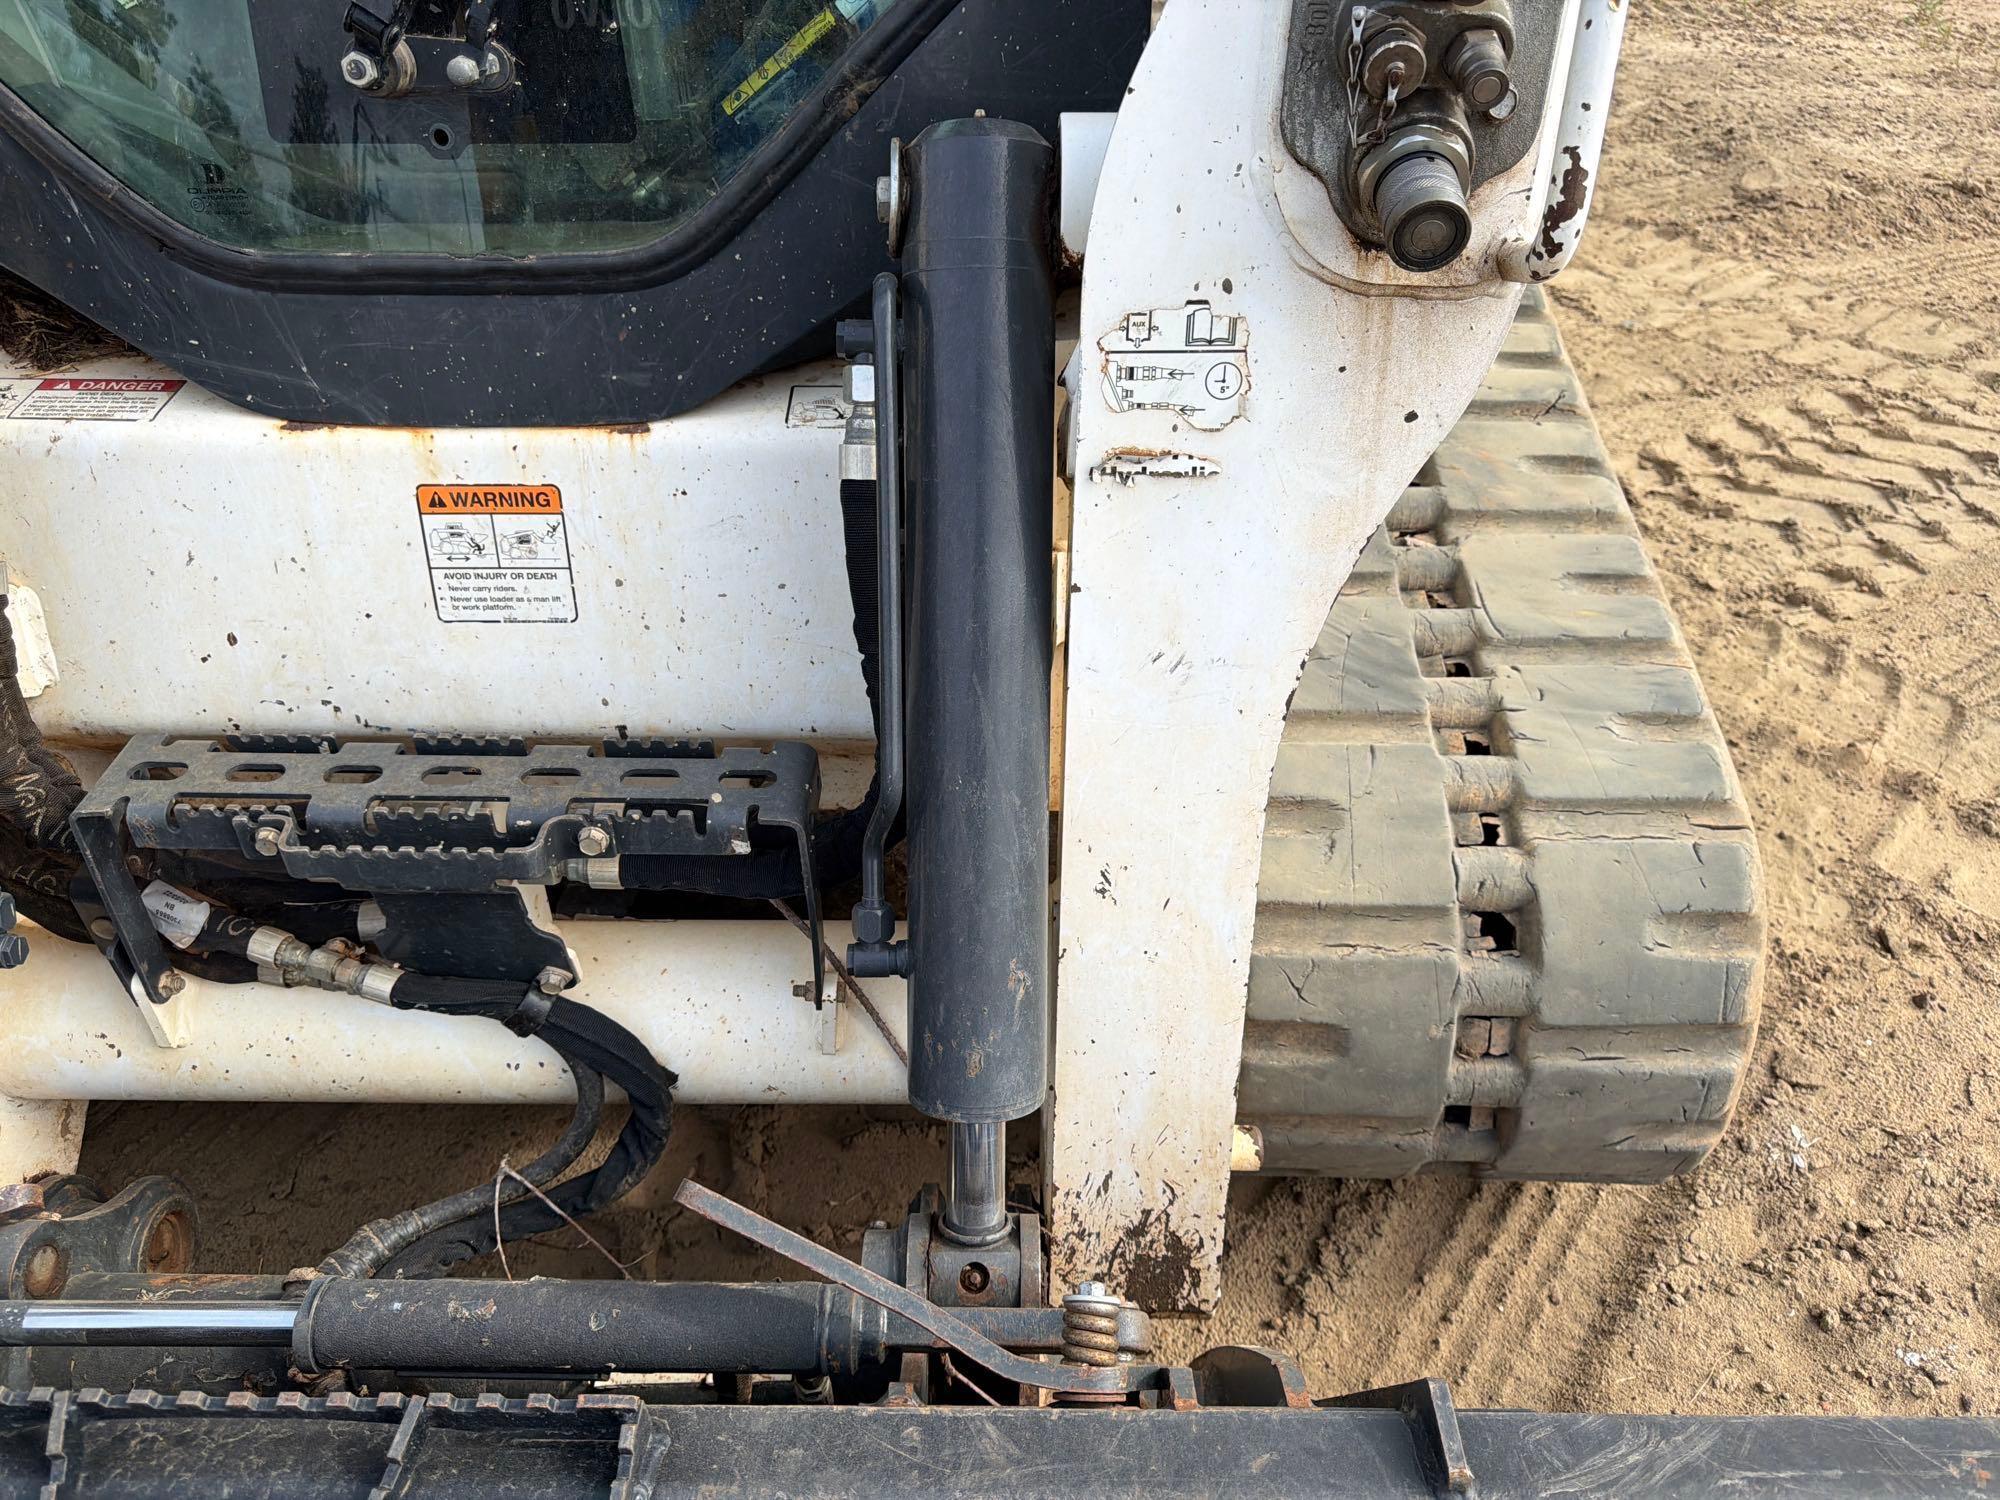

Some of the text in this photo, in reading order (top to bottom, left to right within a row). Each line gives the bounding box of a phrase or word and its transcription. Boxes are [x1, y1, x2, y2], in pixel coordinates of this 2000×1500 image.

[78, 381, 165, 391] DANGER
[449, 491, 551, 508] WARNING
[443, 572, 558, 580] AVOID INJURY OR DEATH
[482, 603, 517, 612] platform.
[164, 901, 176, 912] BN
